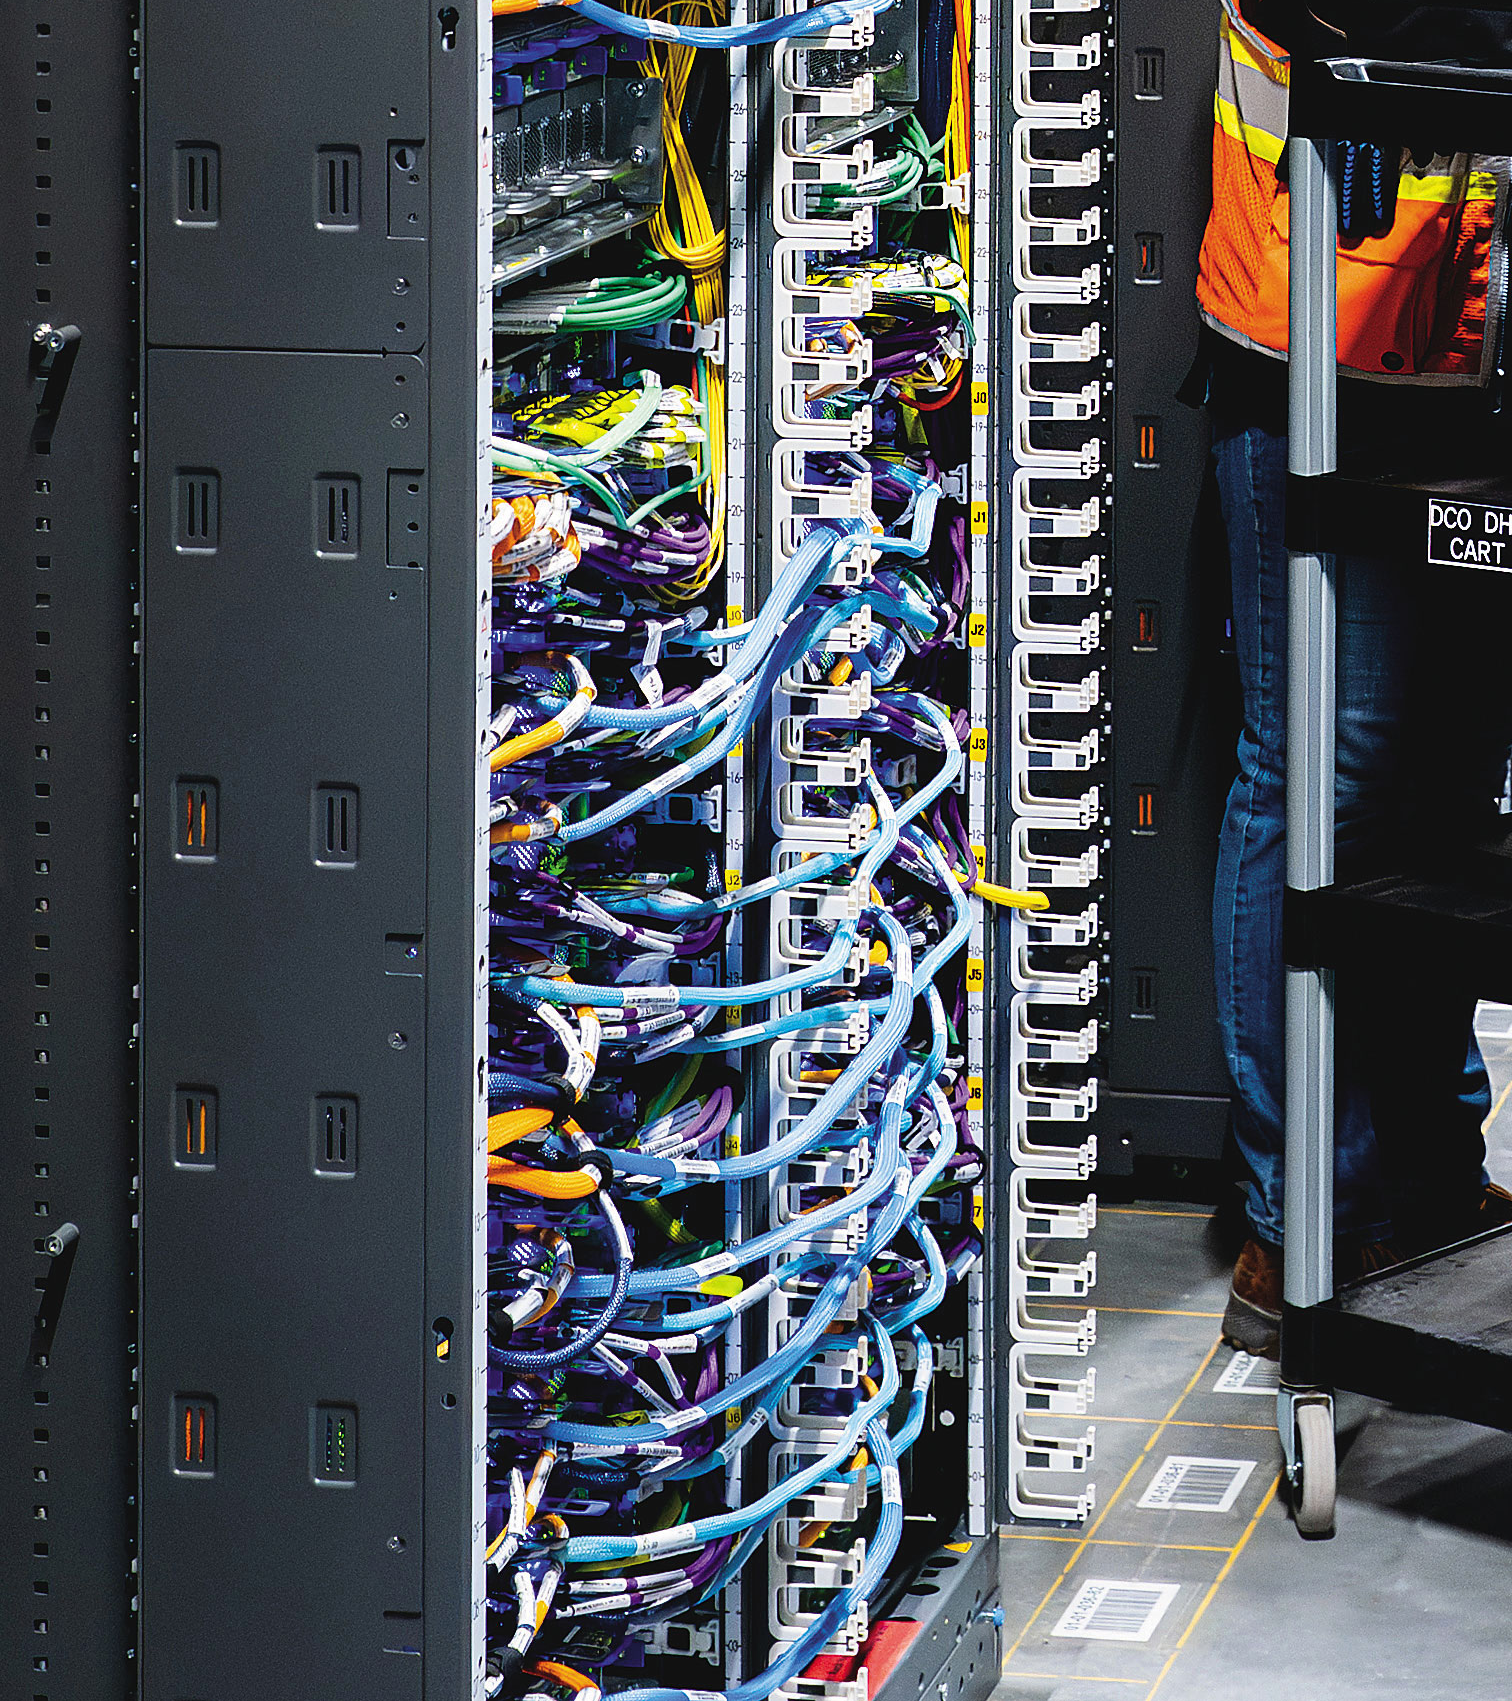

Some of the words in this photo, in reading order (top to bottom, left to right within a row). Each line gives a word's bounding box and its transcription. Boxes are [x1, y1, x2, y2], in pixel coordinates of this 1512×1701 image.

[979, 13, 988, 23] 26
[979, 72, 988, 82] 25
[733, 104, 744, 115] 26
[978, 130, 987, 140] 24
[733, 171, 744, 182] 25
[978, 188, 987, 198] 23
[733, 238, 744, 249] 24
[977, 247, 987, 257] 22
[732, 305, 743, 317] 23
[977, 305, 986, 315] 21
[976, 364, 985, 374] 20
[732, 372, 742, 383] 22
[974, 391, 986, 402] J0
[975, 421, 983, 431] 19
[732, 439, 742, 450] 21
[974, 480, 983, 490] 18
[732, 505, 742, 517] 20
[974, 512, 986, 523] J1
[1430, 504, 1472, 530] DCO
[1484, 511, 1512, 536] DH
[975, 538, 983, 548] 17
[1450, 537, 1506, 564] CART
[731, 572, 741, 583] 19
[975, 597, 984, 607] 16
[971, 624, 985, 635] J2
[975, 655, 983, 665] 15
[974, 713, 982, 723] 14
[972, 738, 986, 749] J3
[730, 772, 740, 784] 16
[973, 771, 982, 781] 13
[972, 830, 981, 840] 12
[730, 839, 740, 850] 15
[728, 876, 740, 886] J2
[970, 946, 979, 956] 10
[968, 970, 982, 980] J5
[971, 1122, 980, 1131] 07
[972, 1472, 981, 1482] 01
